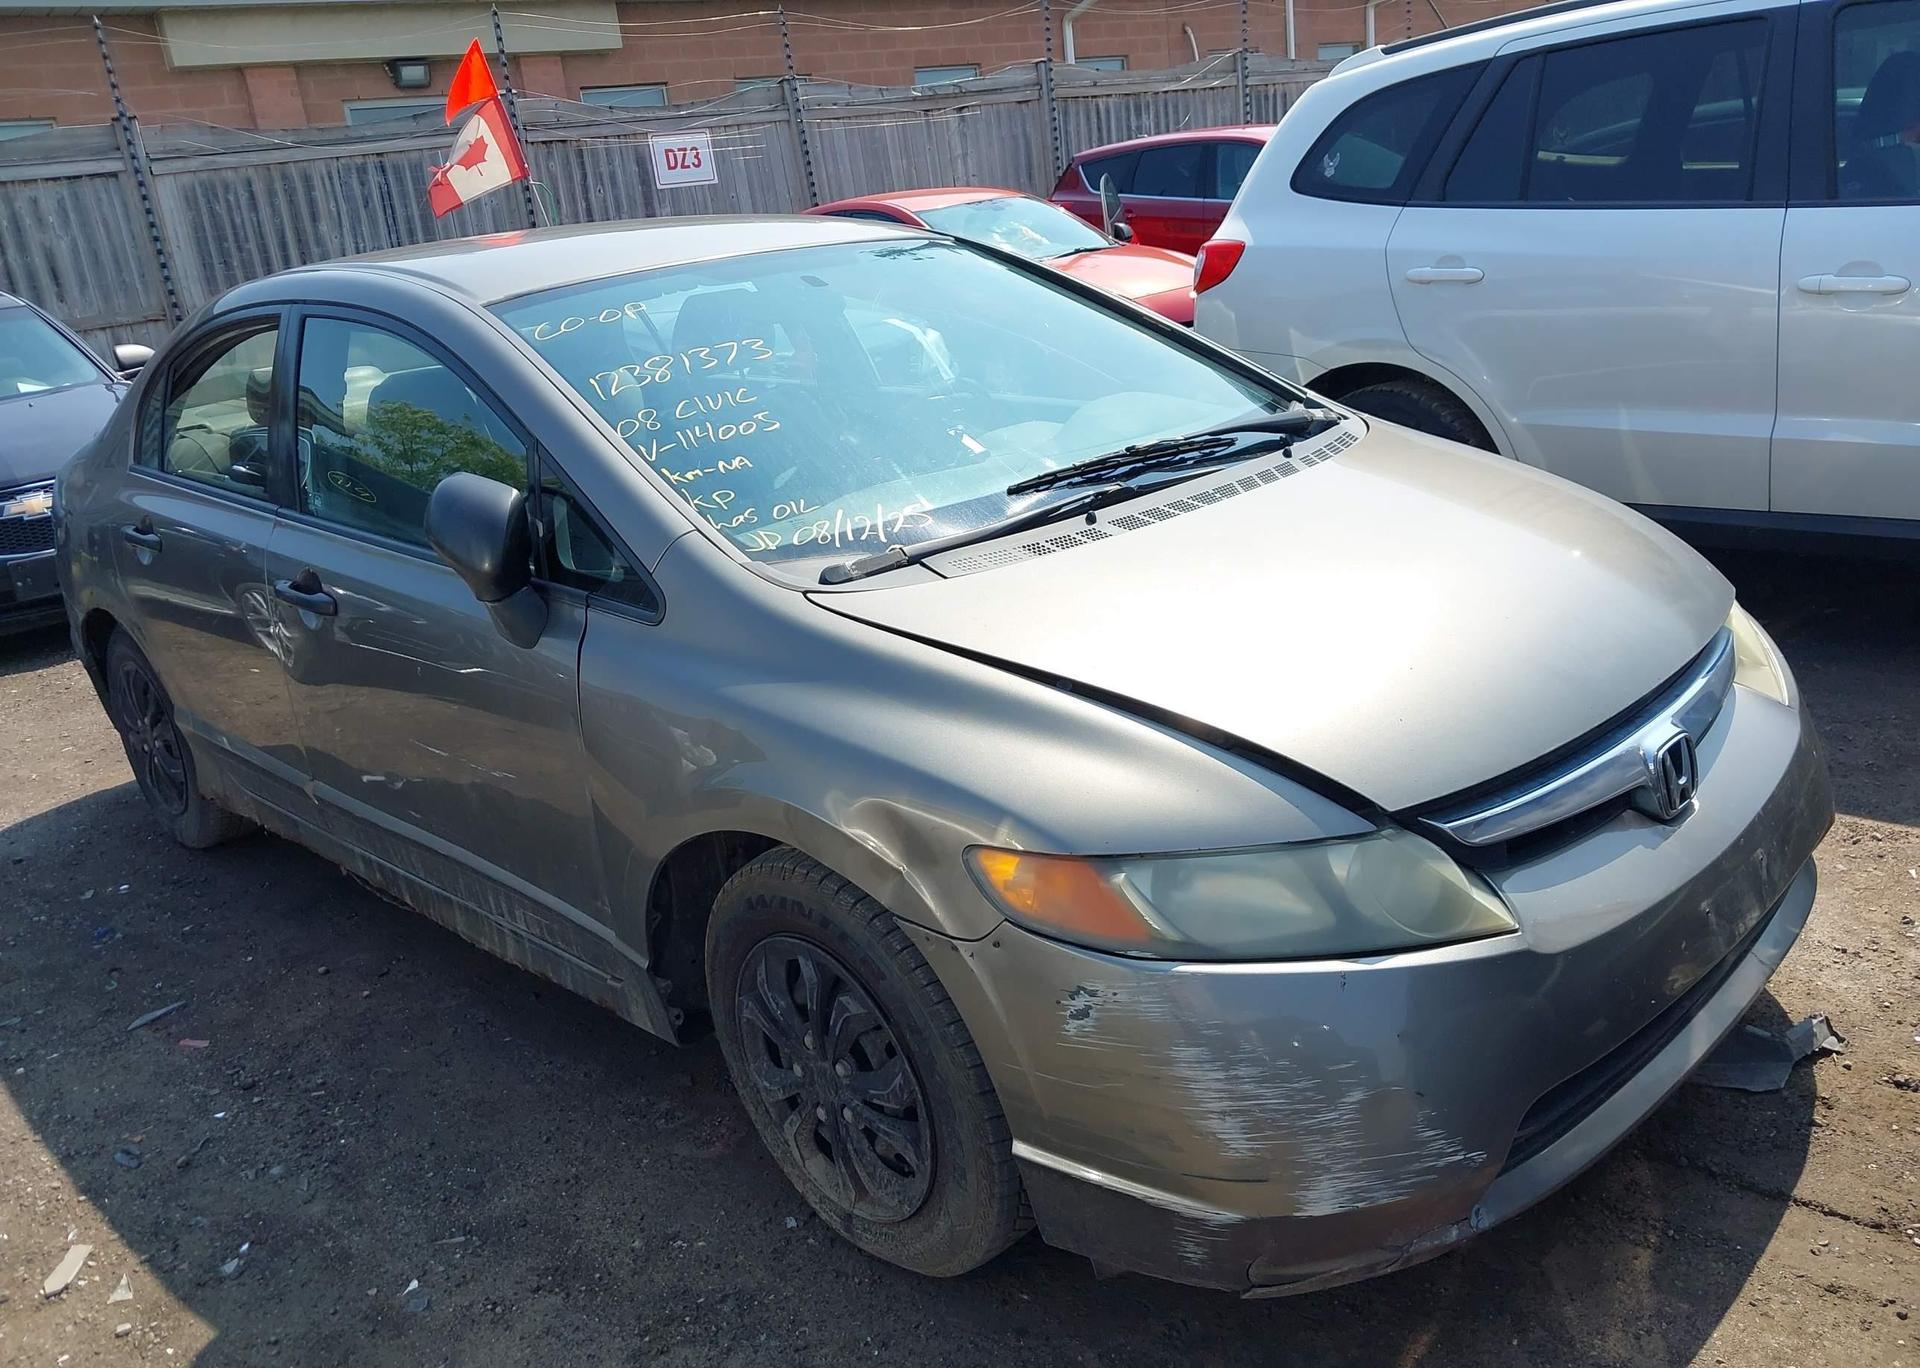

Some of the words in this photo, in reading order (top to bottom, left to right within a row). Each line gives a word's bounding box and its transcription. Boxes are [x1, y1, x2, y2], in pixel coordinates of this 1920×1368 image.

[664, 147, 702, 171] DZ3
[534, 302, 646, 341] CO-OP
[589, 338, 773, 401] 12381373
[617, 408, 661, 439] 08
[675, 387, 758, 419] CIVIC
[638, 411, 781, 461] V-114005
[707, 508, 758, 530] has
[773, 498, 821, 519] OIL
[745, 530, 782, 551] JD
[793, 500, 934, 547] 08/12/25
